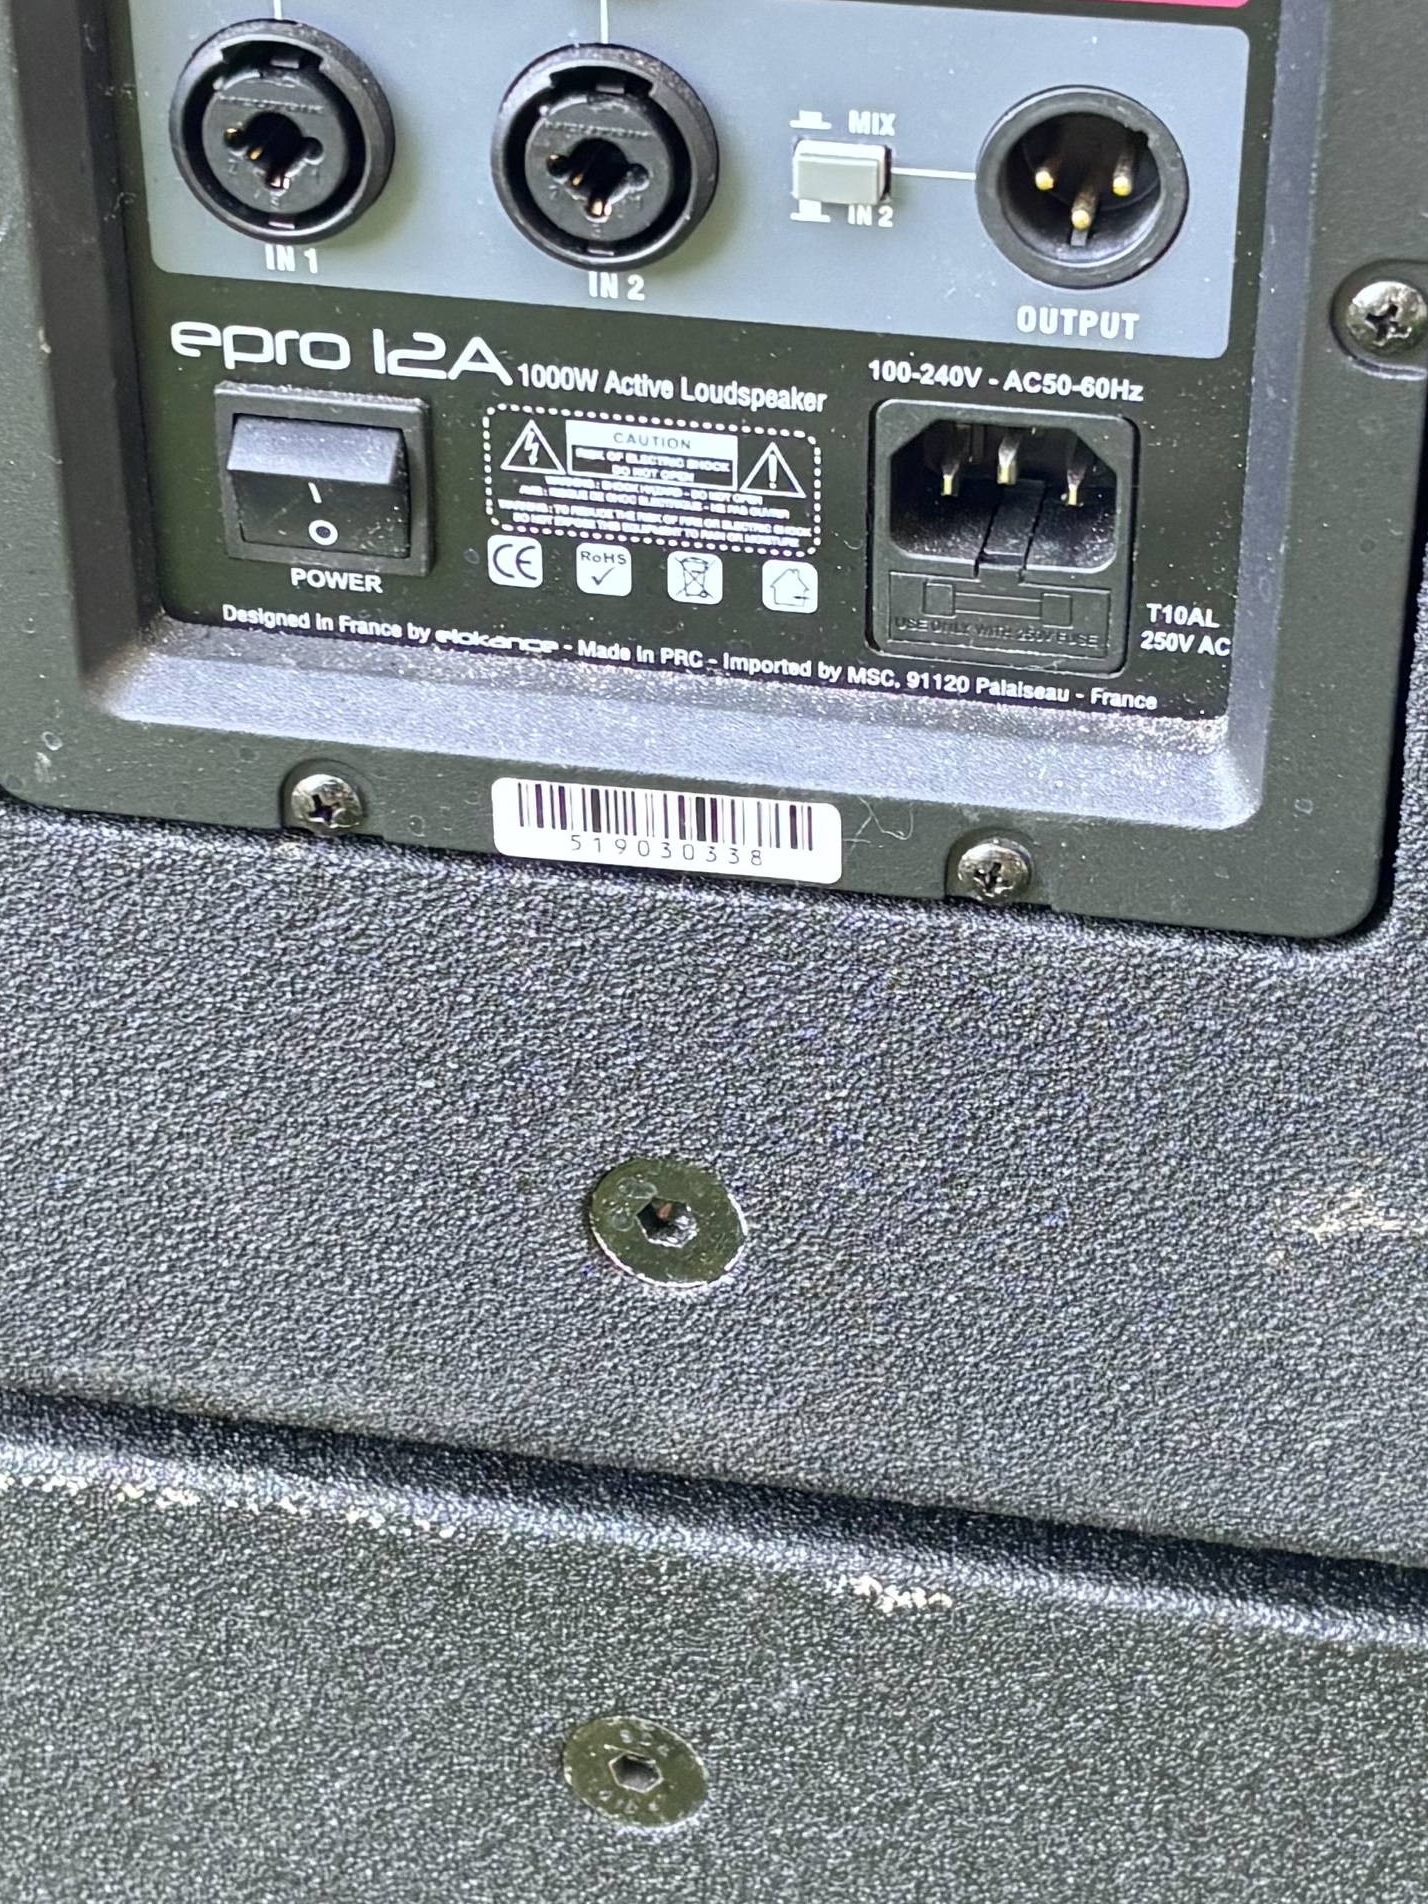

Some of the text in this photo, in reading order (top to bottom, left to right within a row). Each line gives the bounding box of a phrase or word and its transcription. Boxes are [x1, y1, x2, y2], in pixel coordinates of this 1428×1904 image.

[848, 110, 895, 136] MIX
[848, 204, 894, 227] IN 2
[265, 245, 318, 273] IN 1
[588, 272, 645, 301] IN 2
[1016, 305, 1140, 340] OUTPUT
[171, 321, 350, 370] epro
[518, 363, 828, 413] 1000W Active Loudspeaker
[868, 359, 983, 389] 100-240V
[1003, 369, 1144, 402] AC50-60Hz
[613, 432, 691, 450] CAUTION
[580, 550, 627, 565] RoHS
[290, 567, 383, 593] POWER
[1146, 603, 1221, 628] T10AL
[1140, 630, 1231, 656] 250V AC
[222, 604, 311, 629] Designed
[316, 612, 334, 631] in
[339, 615, 402, 638] France
[407, 622, 431, 643] by
[577, 639, 631, 662] Made
[636, 645, 655, 664] in
[660, 647, 703, 668] PRC
[723, 652, 812, 677] Imported
[818, 661, 842, 683] by
[906, 671, 970, 694] 91120
[975, 677, 1070, 703] Palaiseau
[1090, 688, 1158, 711] France
